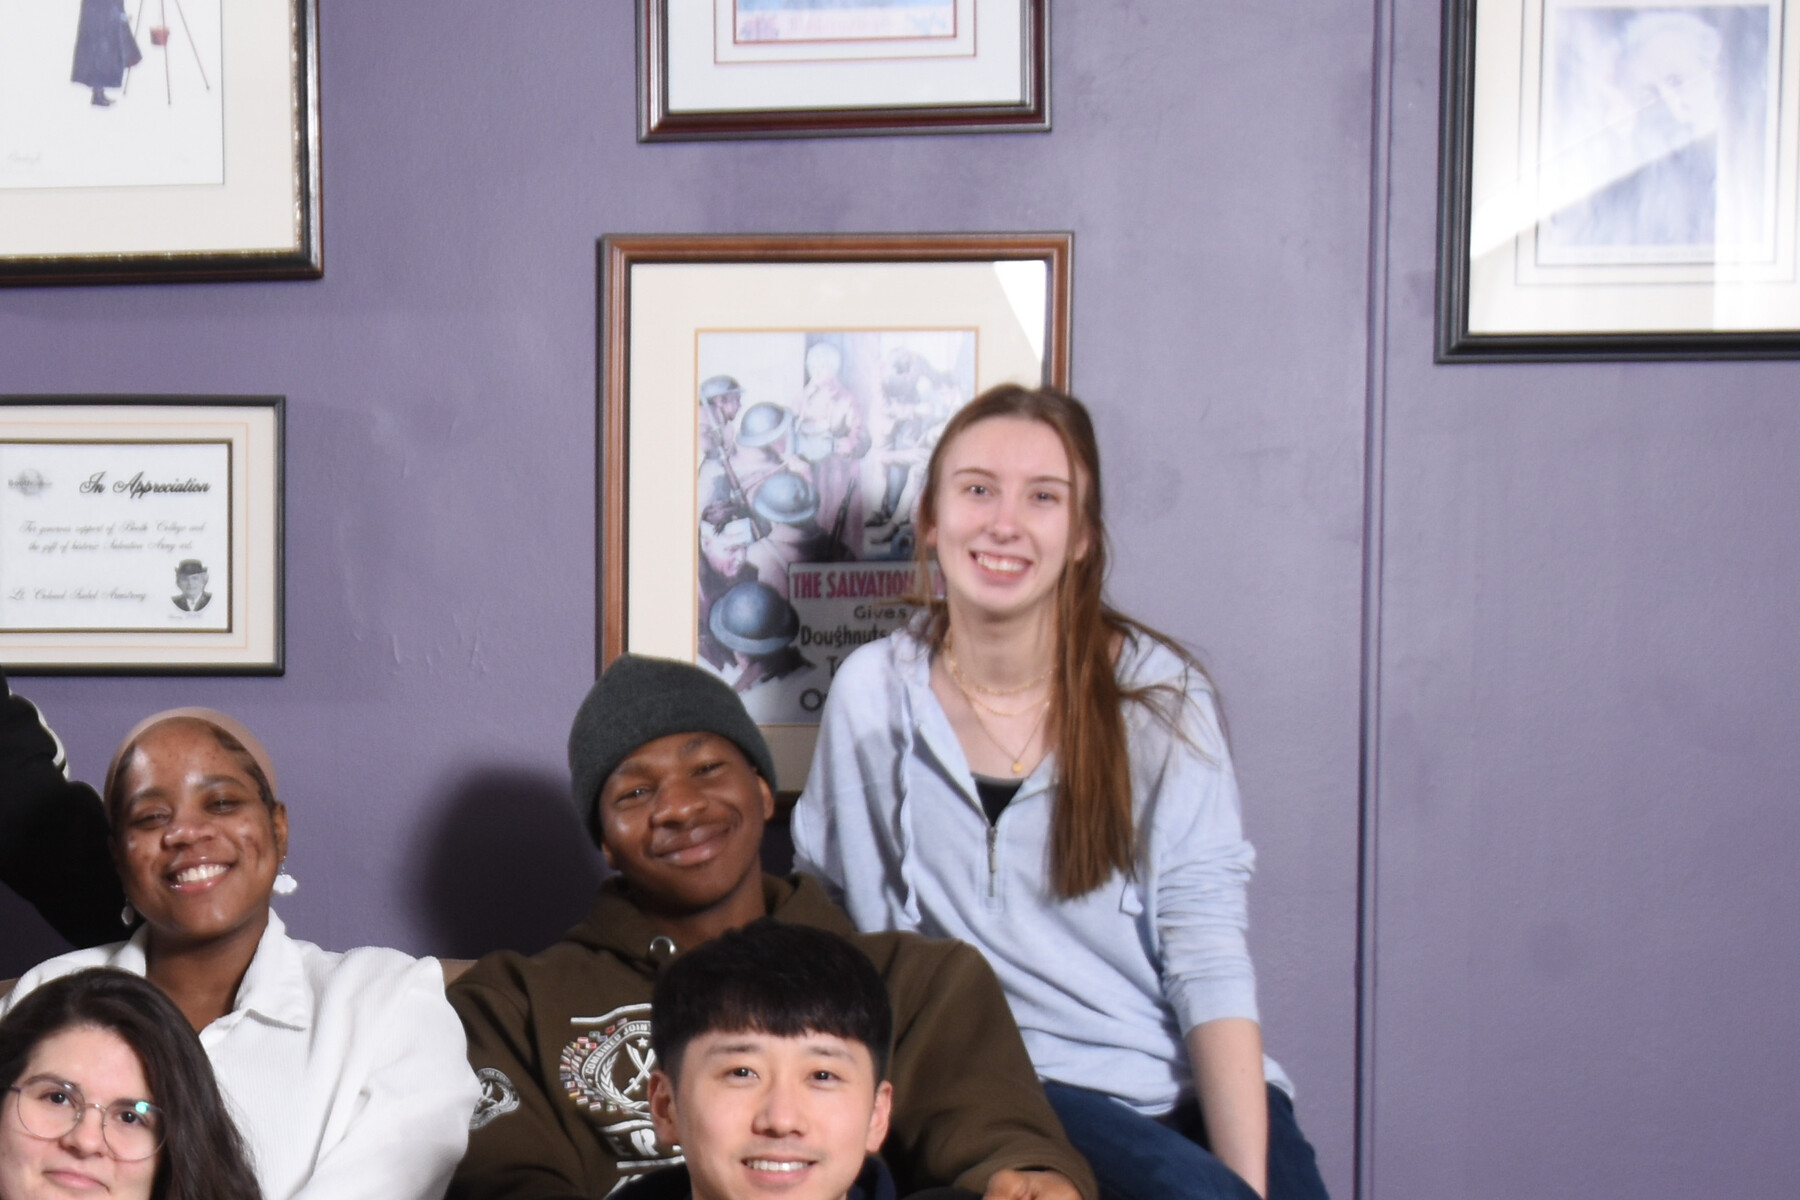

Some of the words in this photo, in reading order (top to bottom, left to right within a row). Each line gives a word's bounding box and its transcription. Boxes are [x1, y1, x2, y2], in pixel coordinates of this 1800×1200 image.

[79, 471, 107, 494] In
[112, 471, 211, 499] Appreciation
[792, 571, 823, 599] THE
[853, 604, 908, 620] Gives
[585, 1033, 621, 1075] COMBINED
